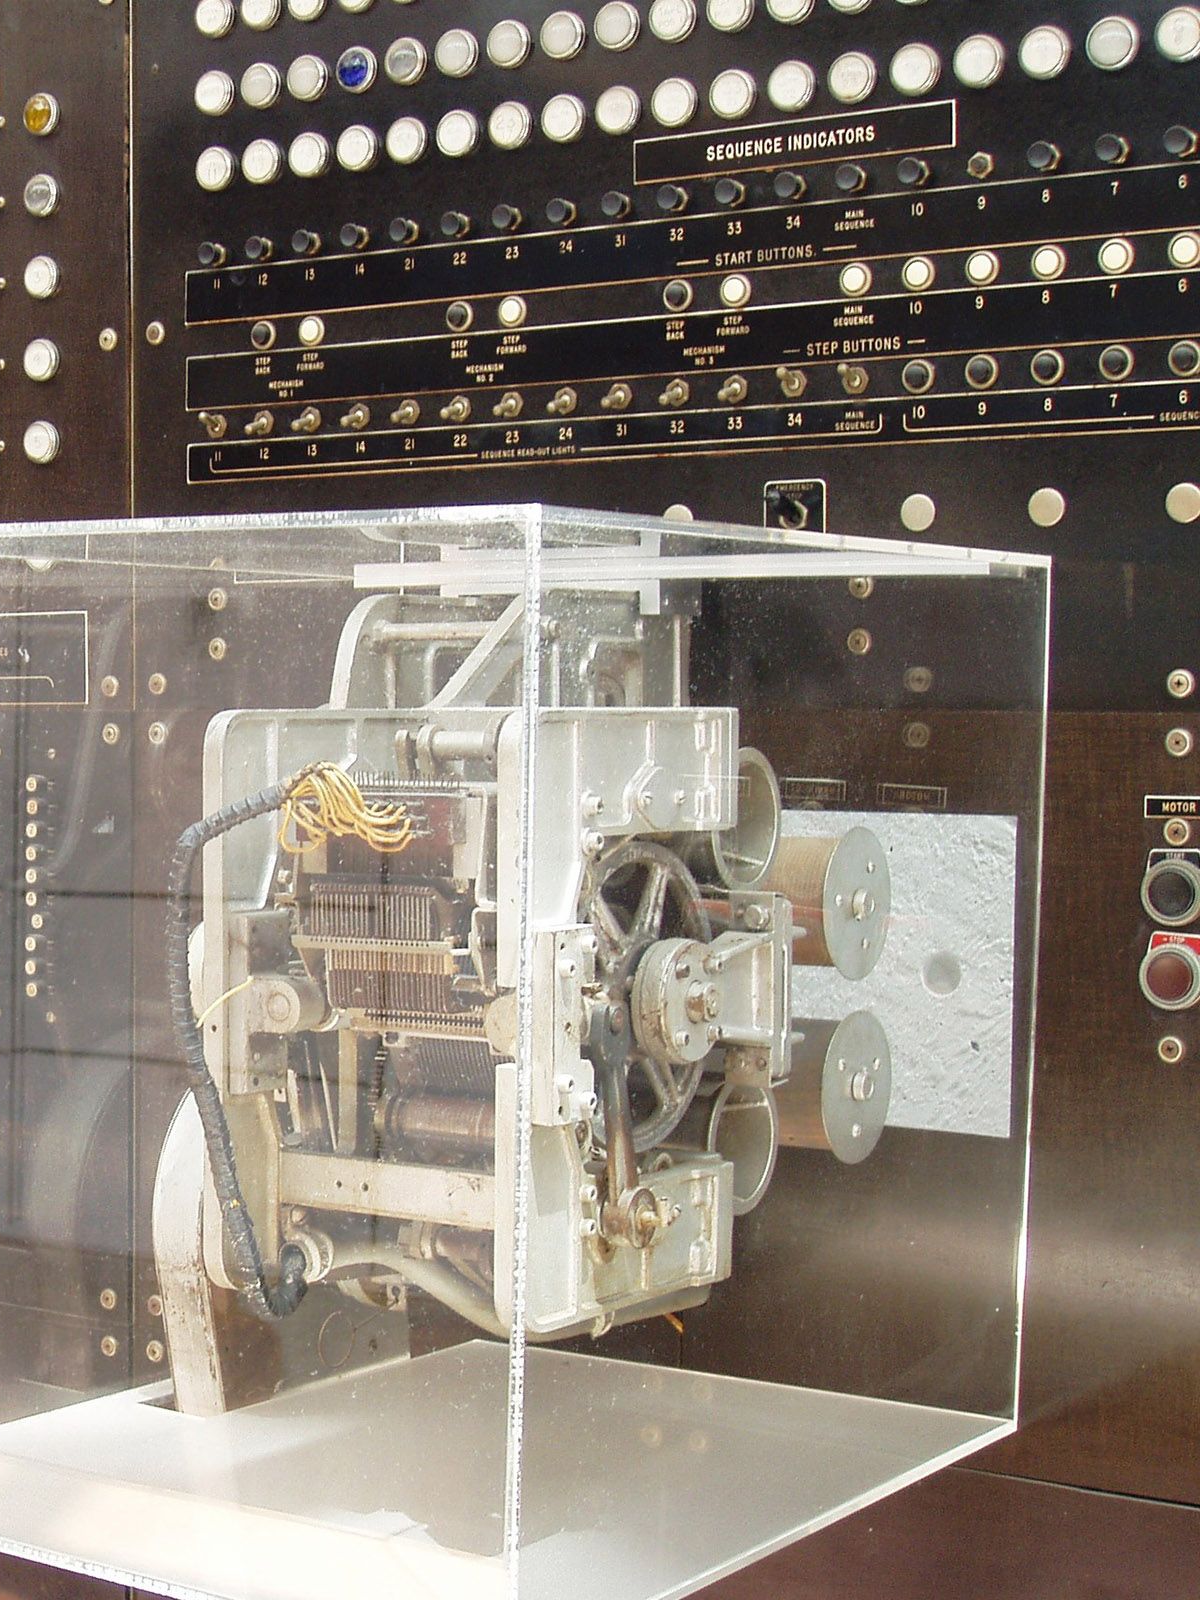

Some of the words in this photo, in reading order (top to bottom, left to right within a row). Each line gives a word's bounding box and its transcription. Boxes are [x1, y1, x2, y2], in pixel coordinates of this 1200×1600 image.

[706, 136, 783, 162] SEQUENCE
[787, 125, 876, 152] INDICATORS
[911, 202, 924, 216] 10
[977, 196, 986, 210] 9
[1042, 189, 1050, 203] 8
[1110, 181, 1120, 195] 7
[1178, 174, 1188, 189] 6
[845, 209, 864, 219] MAIN
[834, 218, 875, 232] SEQUENCE
[214, 279, 220, 289] 11
[258, 274, 268, 286] 12
[305, 269, 315, 281] 13
[355, 263, 365, 275] 14
[405, 258, 414, 270] 21
[453, 252, 467, 265] 22
[505, 246, 519, 260] 23
[559, 240, 573, 254] 24
[615, 234, 626, 247] 31
[669, 228, 684, 242] 32
[727, 221, 742, 235] 33
[786, 215, 801, 230] 34
[715, 250, 752, 267] START
[909, 301, 923, 315] 10
[975, 296, 984, 310] 9
[1042, 290, 1050, 304] 8
[1109, 284, 1119, 298] 7
[1178, 278, 1188, 293] 6
[843, 305, 862, 315] MAIN
[666, 320, 685, 330] STEP
[723, 315, 743, 326] STEP
[833, 314, 874, 327] SEQUENCE
[666, 330, 685, 341] BACK
[716, 324, 750, 336] FORWARD
[451, 340, 468, 349] STEP
[503, 335, 520, 345] STEP
[496, 344, 527, 355] FORWARD
[683, 345, 726, 357] MECHANISM
[806, 340, 838, 357] STEP
[843, 336, 901, 354] BUTTONS
[303, 353, 318, 361] STEP
[451, 350, 468, 359] BACK
[255, 357, 271, 366] STEP
[296, 361, 325, 371] FORWARD
[255, 366, 271, 375] BACK
[466, 363, 504, 374] MECHANISM
[268, 379, 304, 389] MECHANISM
[912, 405, 925, 419] 10
[978, 402, 986, 416] 9
[1044, 398, 1052, 412] 8
[1109, 394, 1118, 408] 7
[1179, 390, 1188, 404] 6
[845, 410, 864, 419] MAIN
[834, 419, 875, 431] SEQUENCE
[214, 451, 221, 461] 11
[259, 447, 269, 459] 12
[307, 445, 317, 457] 13
[355, 441, 366, 453] 14
[404, 438, 415, 450] 21
[453, 434, 467, 447] 22
[505, 430, 520, 444] 23
[559, 427, 573, 440] 24
[616, 424, 627, 437] 31
[669, 420, 685, 434] 32
[727, 416, 743, 430] 33
[787, 413, 802, 427] 34
[481, 448, 515, 459] SEQUENCE
[551, 445, 576, 455] LIGHTS
[1162, 801, 1197, 813] MOTOR
